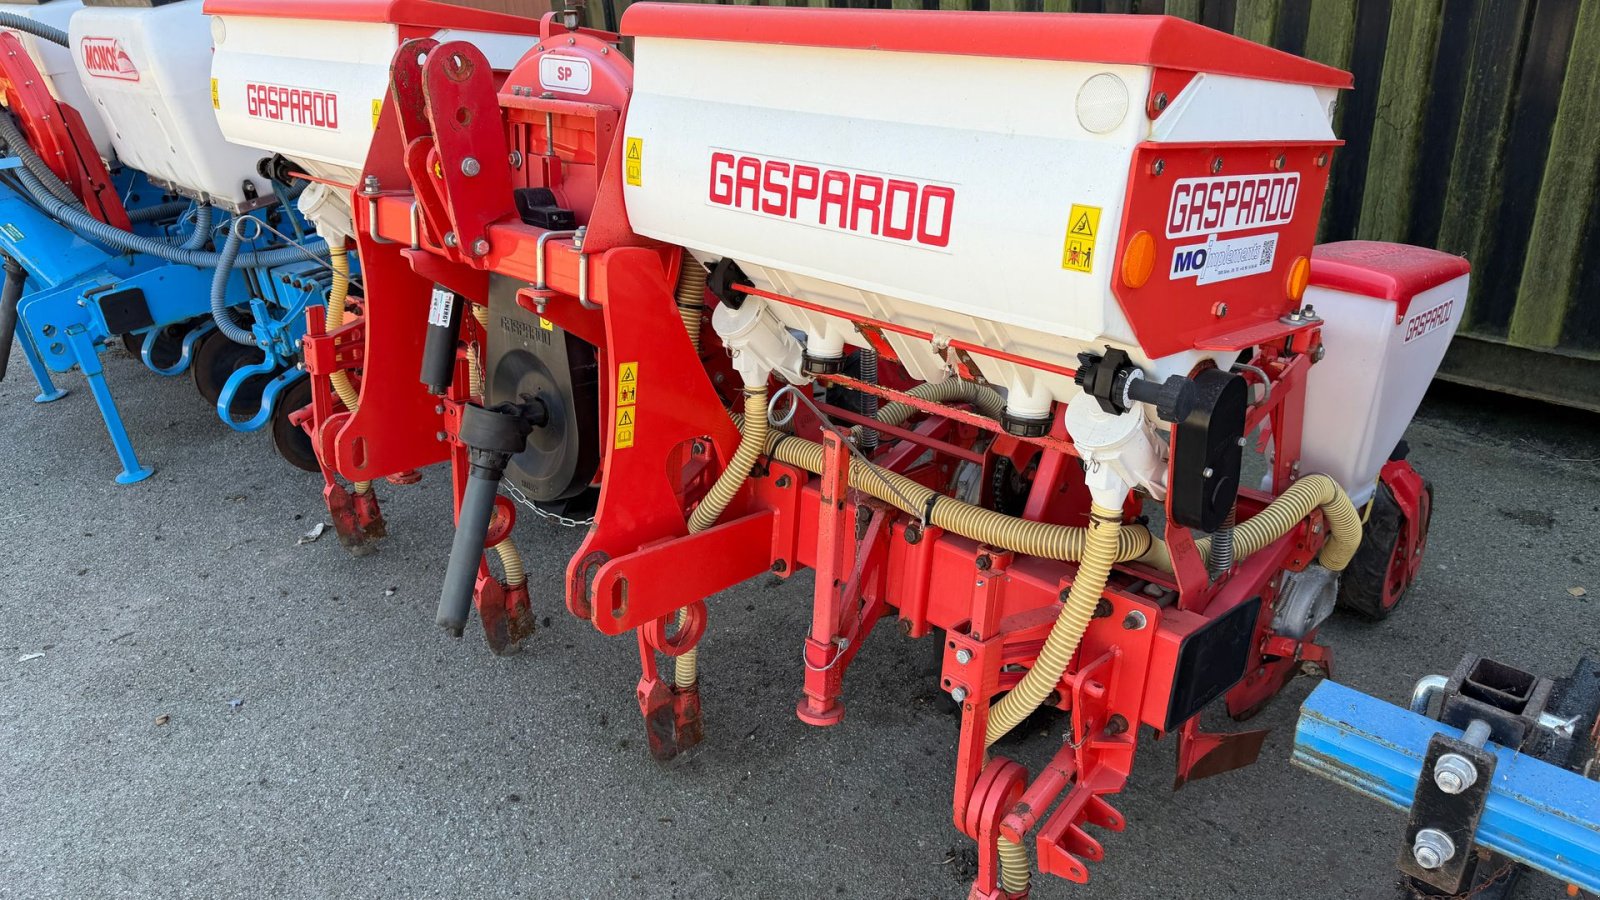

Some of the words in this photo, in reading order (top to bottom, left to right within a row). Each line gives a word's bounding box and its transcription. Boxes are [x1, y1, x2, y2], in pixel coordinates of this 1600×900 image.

[557, 66, 573, 81] SP
[247, 84, 338, 129] GASPARDO
[709, 151, 956, 248] GASPARDO
[1168, 177, 1299, 234] GASPARDO
[1174, 249, 1208, 273] MO
[1404, 300, 1454, 342] GASPARDO
